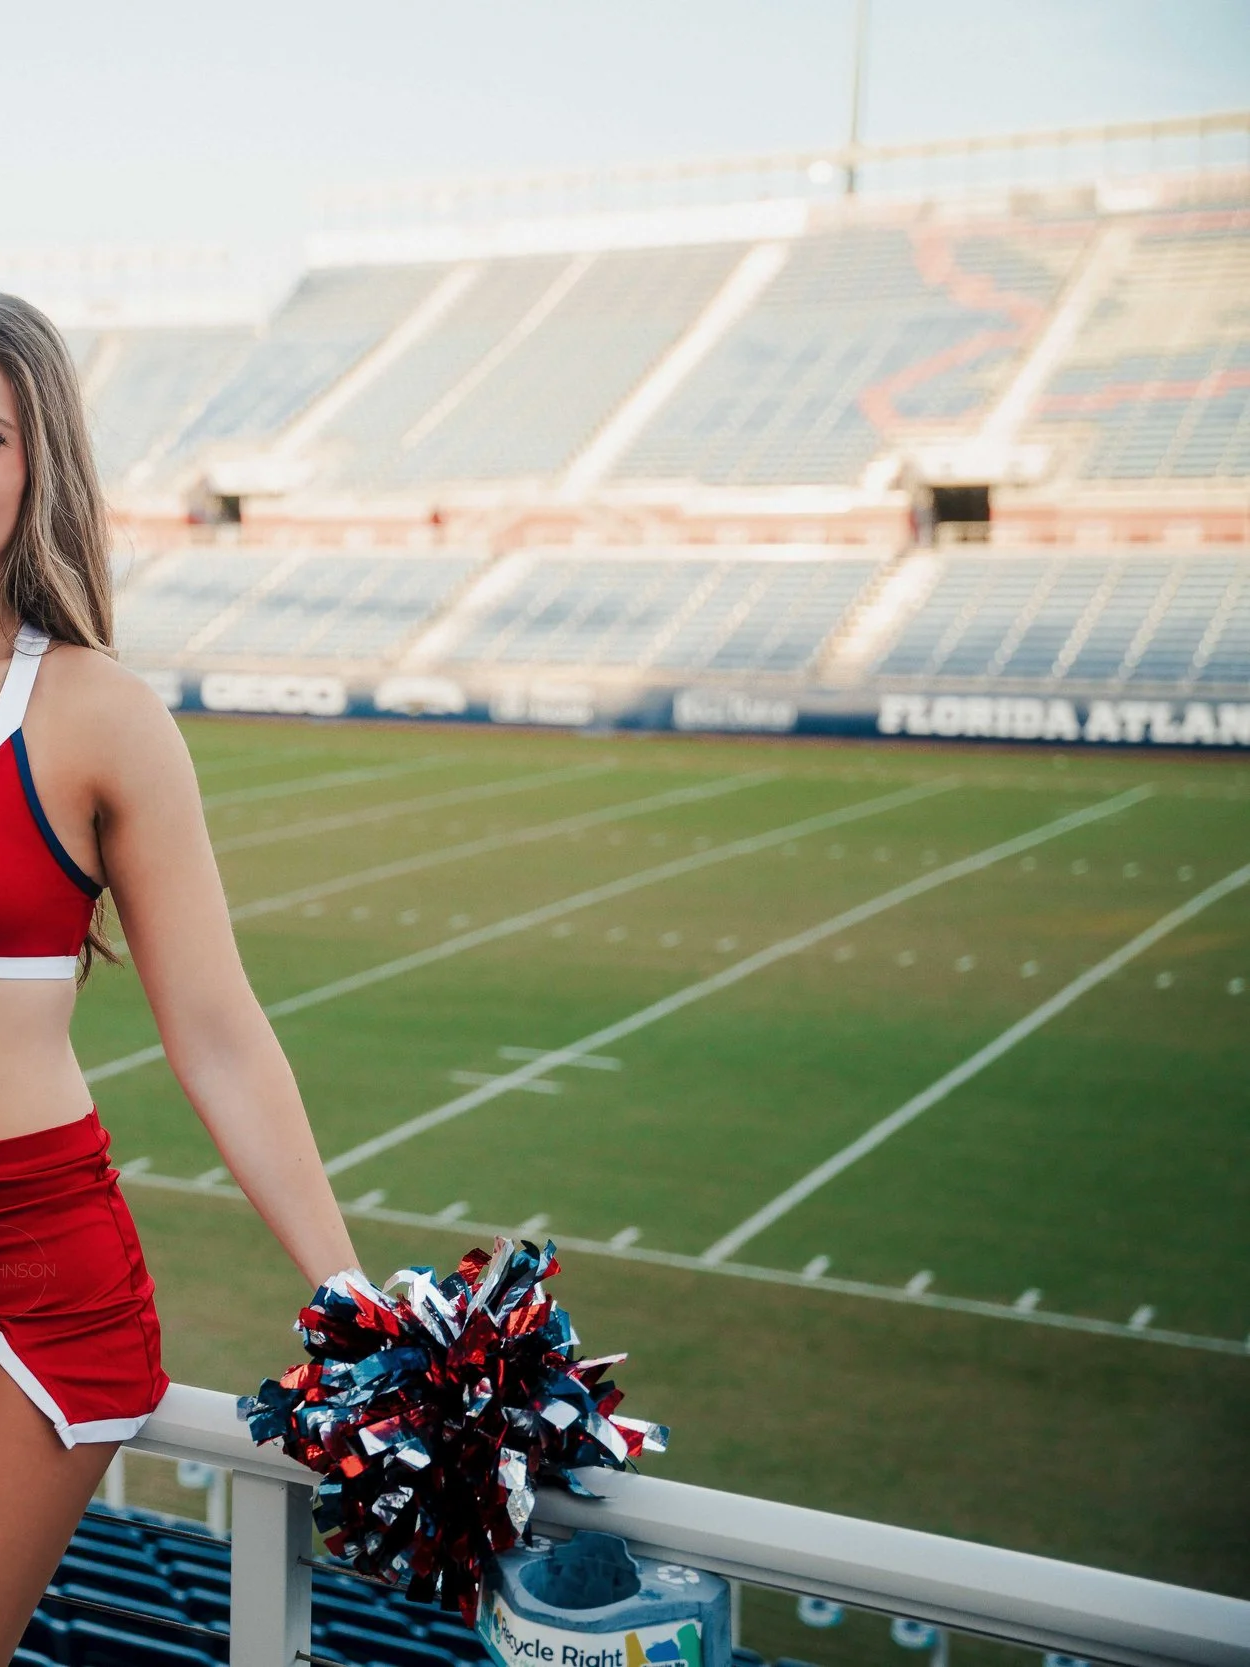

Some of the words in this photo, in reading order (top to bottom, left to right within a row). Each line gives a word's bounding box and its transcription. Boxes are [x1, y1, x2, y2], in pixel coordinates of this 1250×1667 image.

[878, 696, 1080, 740] FLORIDA
[501, 1617, 554, 1662] Recycle
[562, 1645, 623, 1667] Right
